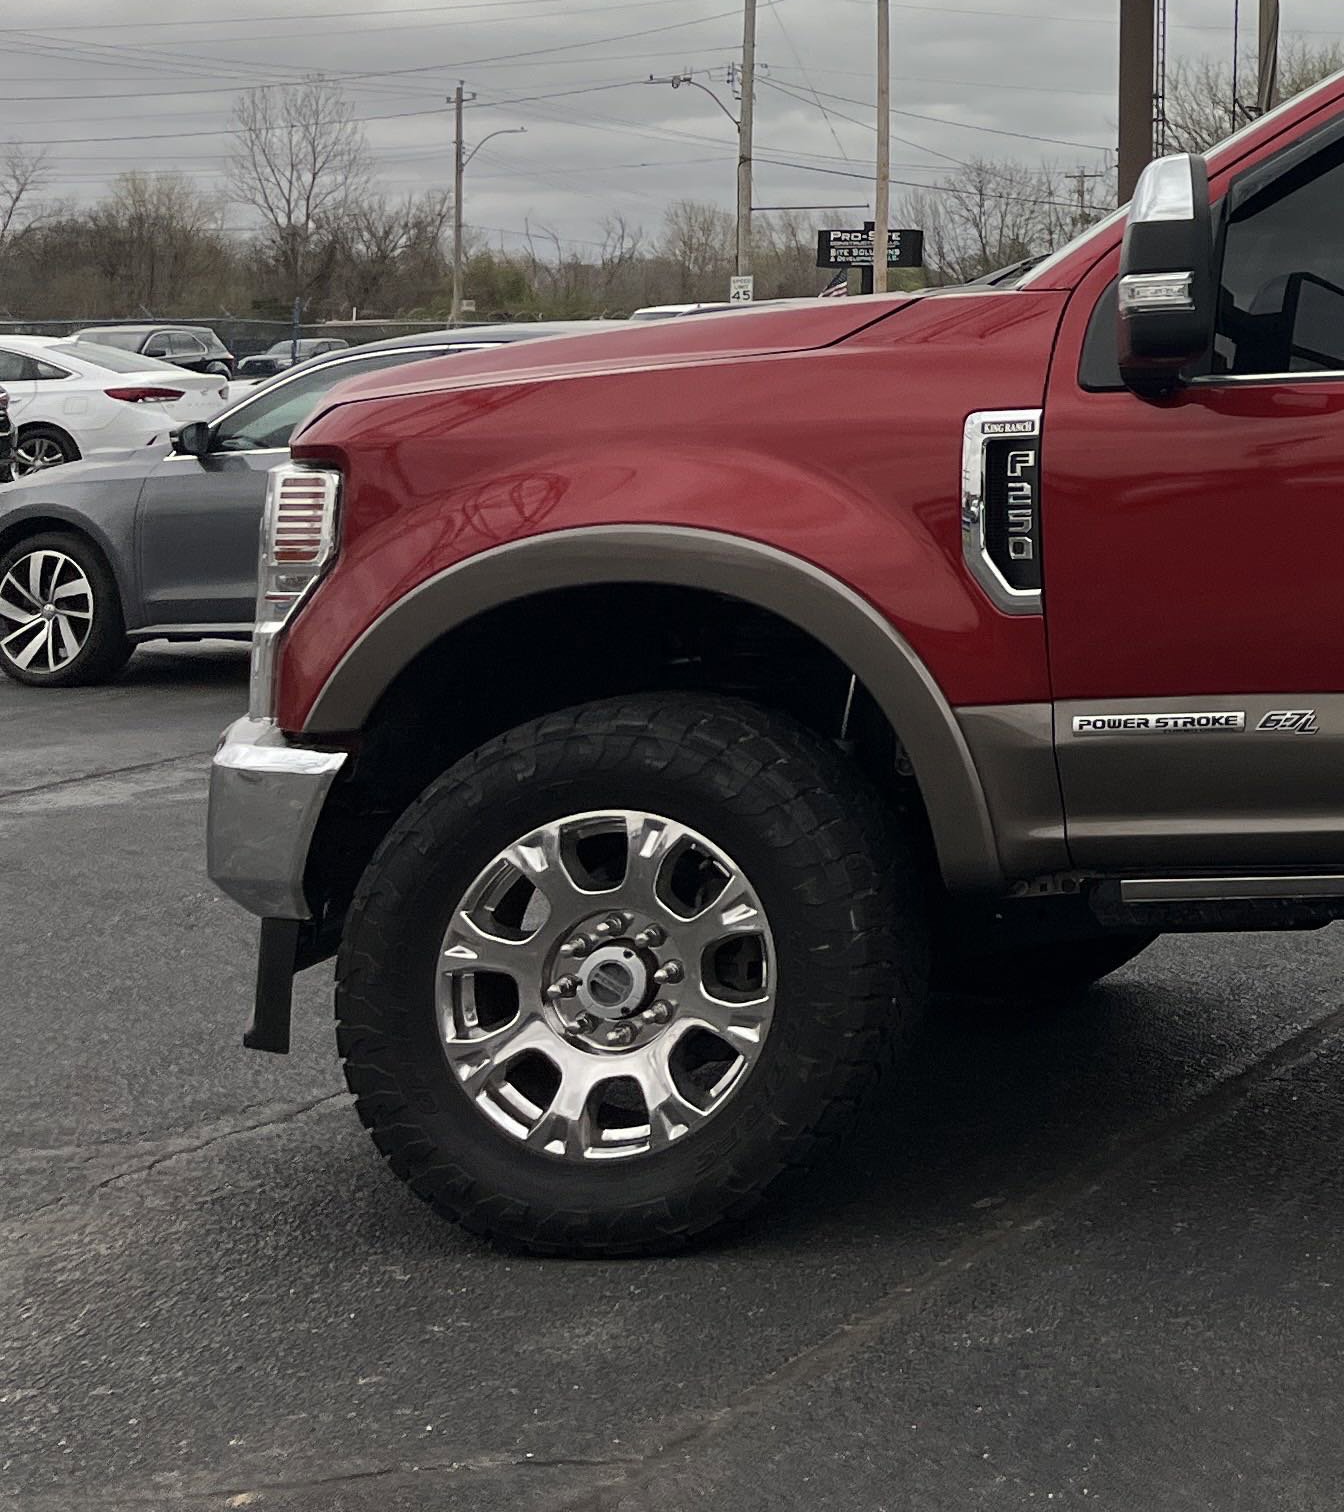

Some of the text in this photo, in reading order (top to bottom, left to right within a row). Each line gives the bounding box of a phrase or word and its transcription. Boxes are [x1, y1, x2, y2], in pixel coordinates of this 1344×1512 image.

[731, 290, 751, 301] 45
[984, 421, 1033, 433] KING RANCH
[1007, 450, 1035, 560] F250
[1078, 709, 1321, 735] POWER STROKE 6.7L
